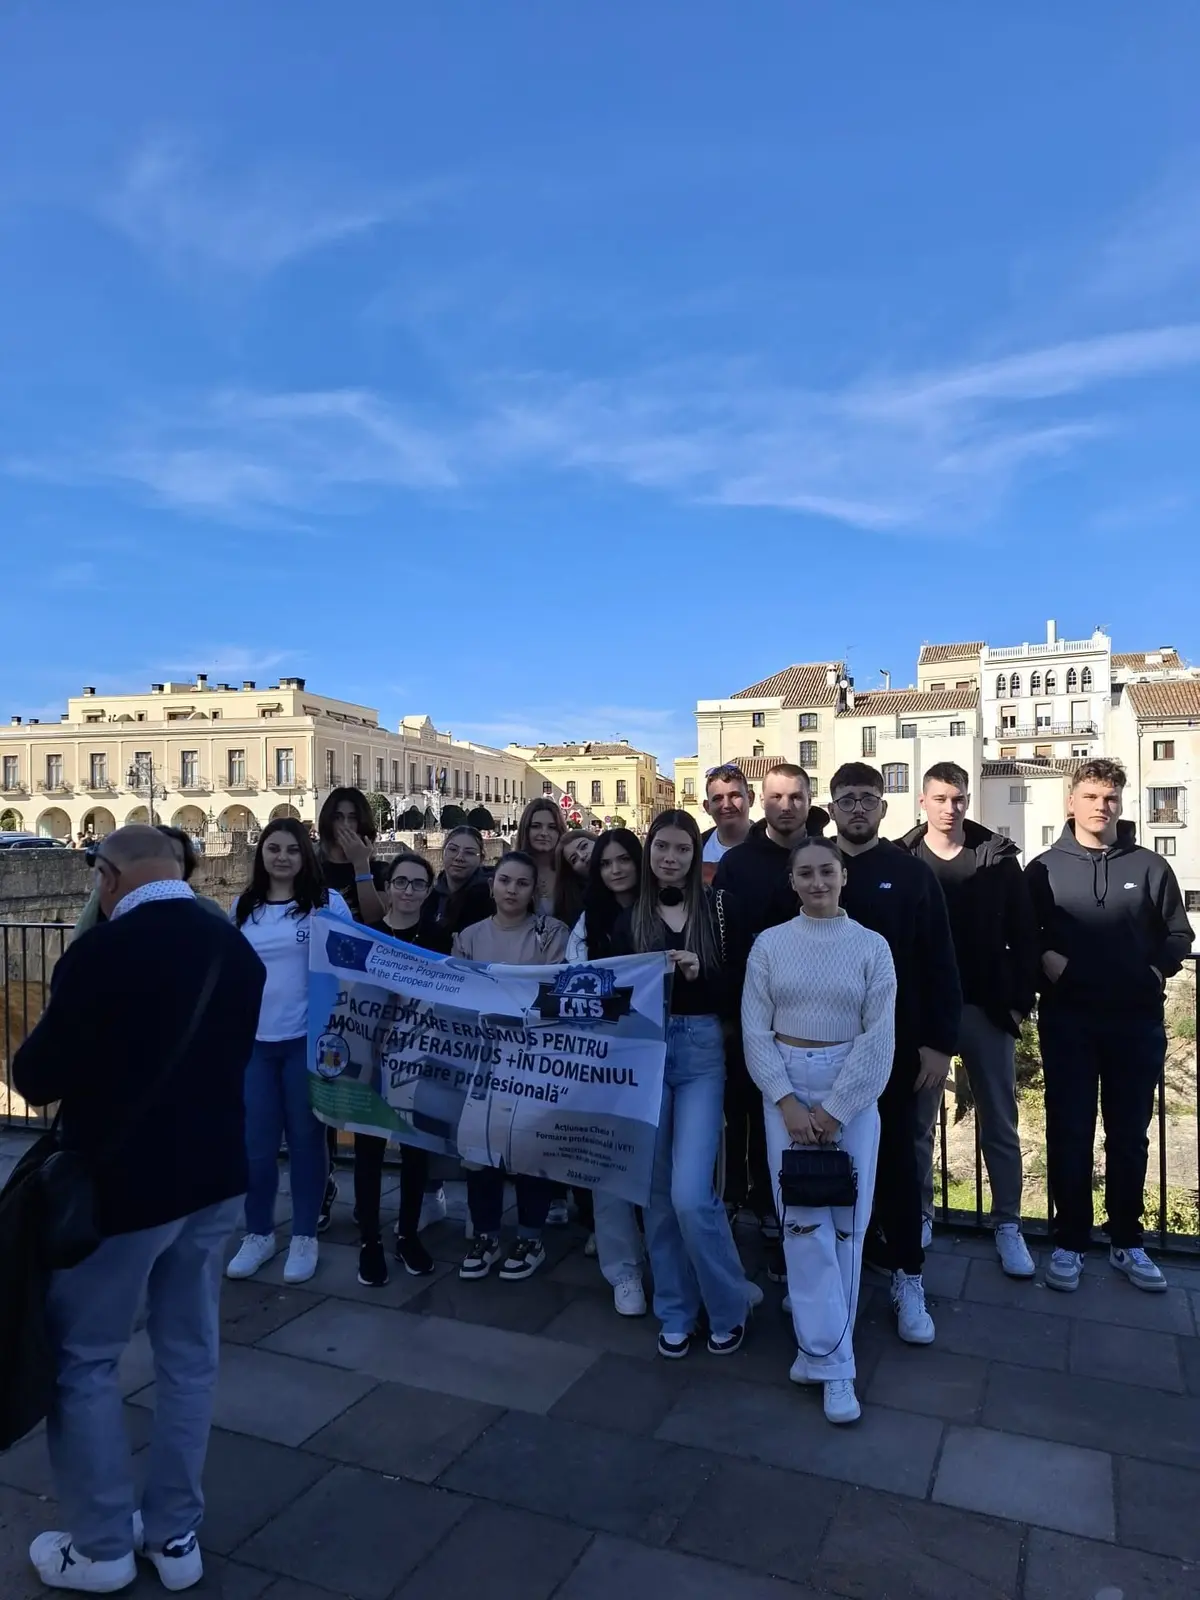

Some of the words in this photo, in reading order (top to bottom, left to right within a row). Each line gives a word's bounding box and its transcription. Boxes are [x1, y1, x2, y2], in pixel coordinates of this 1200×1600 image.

[370, 955, 414, 971] Erasmus+
[416, 966, 465, 983] Programme
[392, 972, 433, 988] European
[435, 982, 460, 994] Union
[558, 996, 604, 1018] LTS
[349, 998, 449, 1033] ACREDITARE
[452, 1018, 539, 1047] ERASMUS
[543, 1032, 609, 1060] PENTRU
[381, 1053, 451, 1082] Formare
[419, 1034, 502, 1065] ERASMUS
[539, 1056, 639, 1087] DOMENIUL
